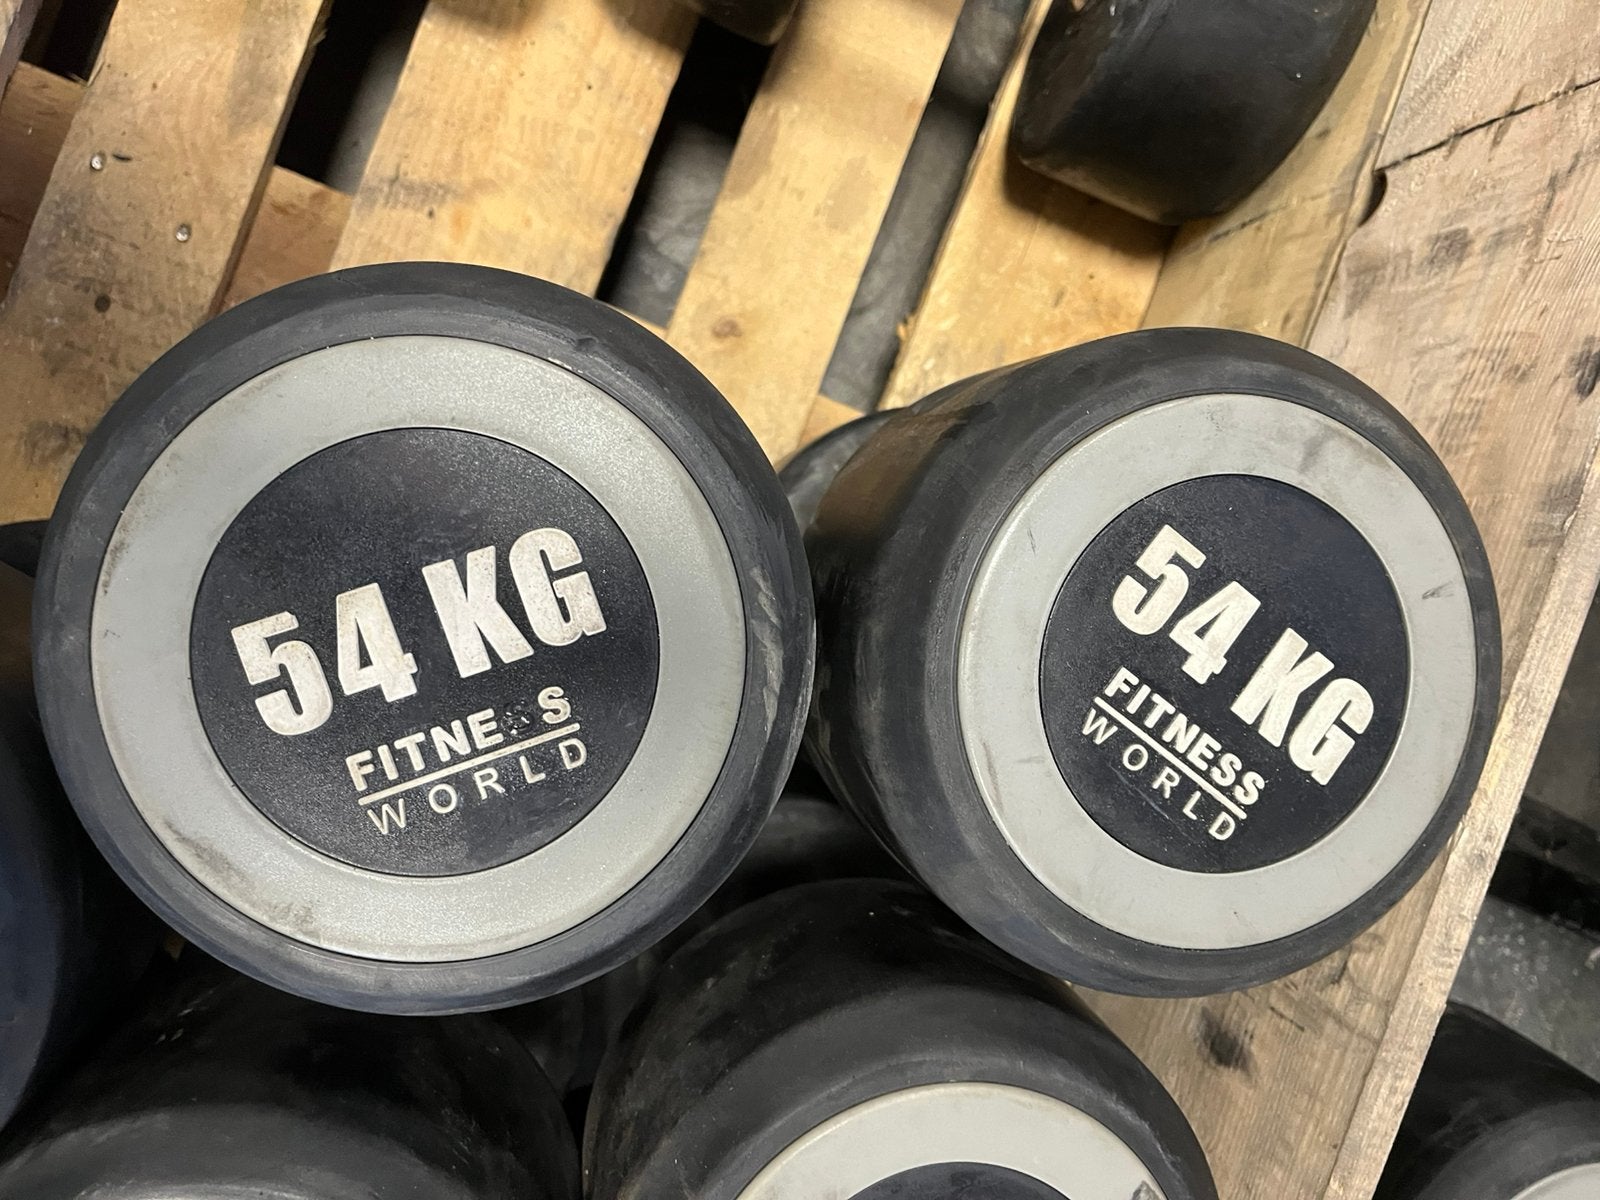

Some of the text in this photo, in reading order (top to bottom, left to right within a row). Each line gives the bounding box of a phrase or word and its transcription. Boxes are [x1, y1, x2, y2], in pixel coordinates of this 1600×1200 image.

[231, 528, 607, 735] 54 KG
[1112, 524, 1374, 786] 54 KG
[368, 737, 588, 834] WORLD
[1081, 708, 1236, 841] WORLD
[1104, 666, 1265, 806] FITNESS
